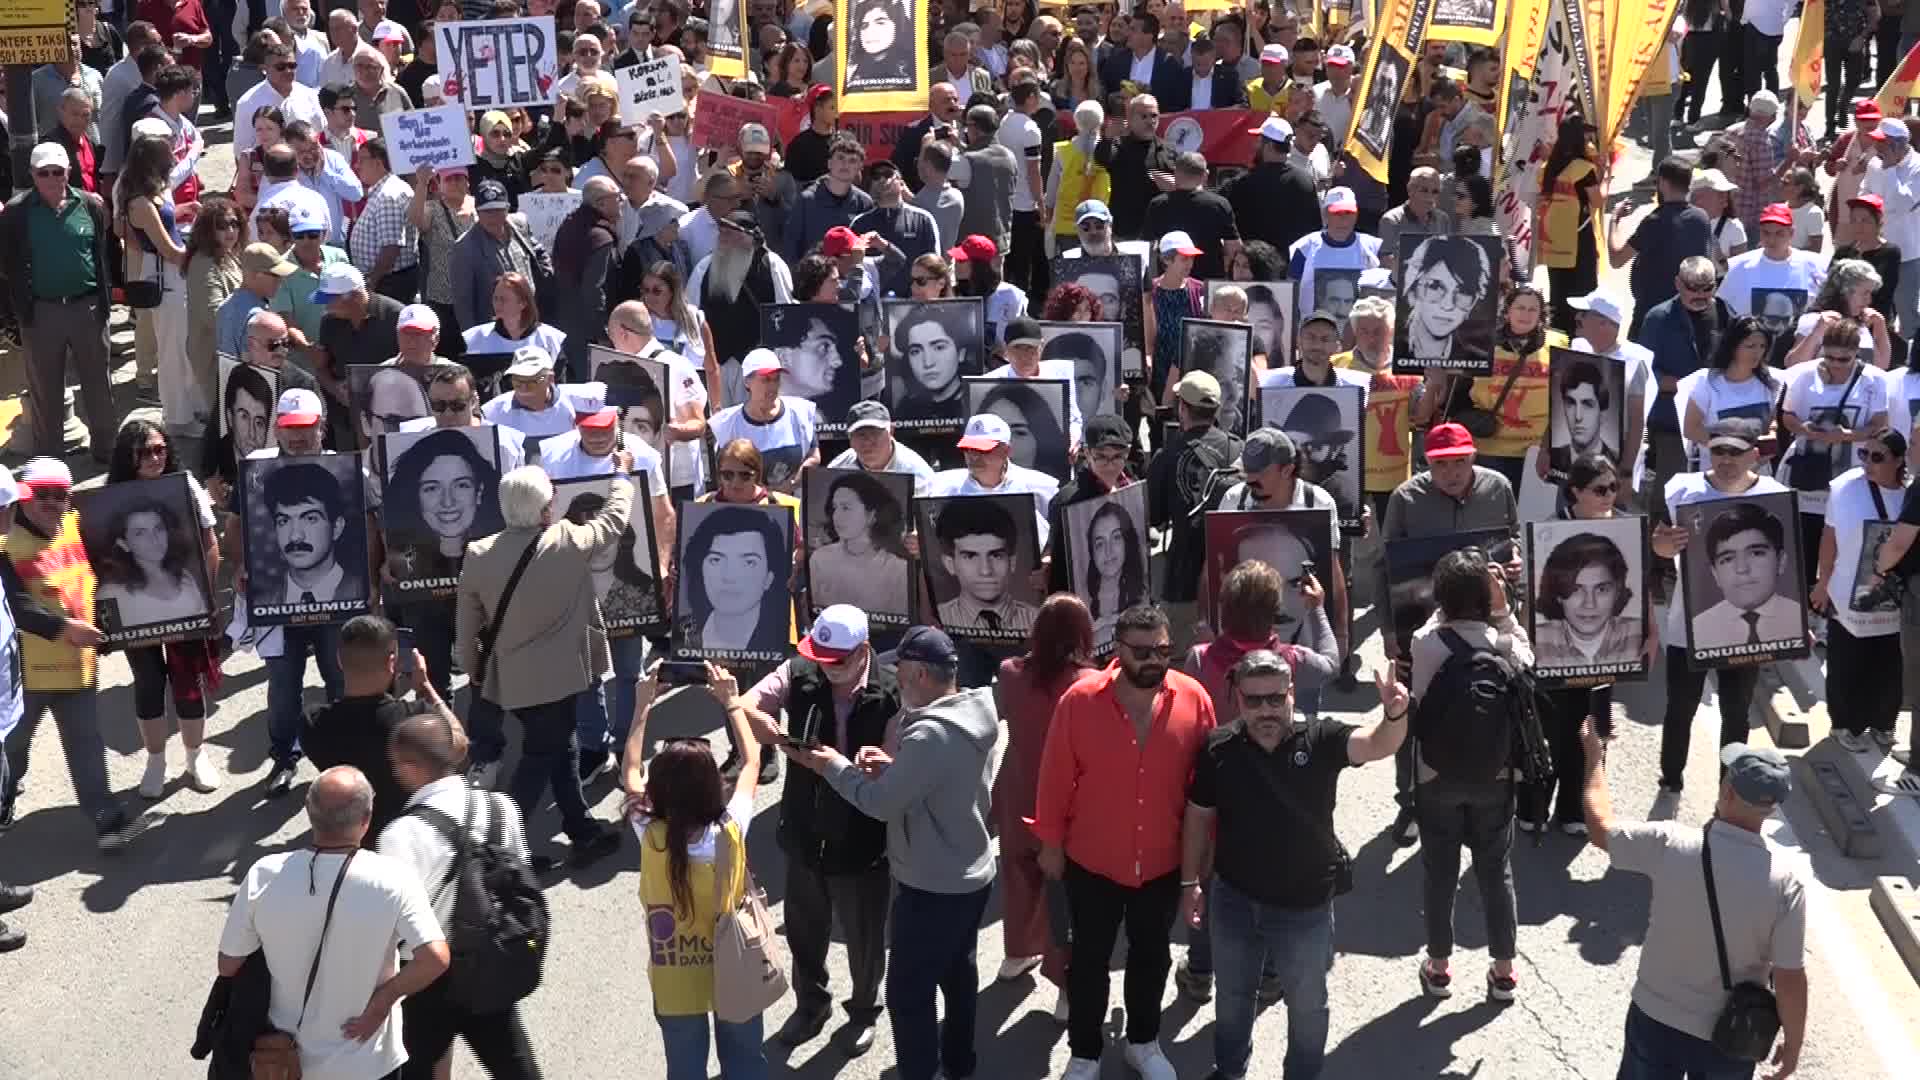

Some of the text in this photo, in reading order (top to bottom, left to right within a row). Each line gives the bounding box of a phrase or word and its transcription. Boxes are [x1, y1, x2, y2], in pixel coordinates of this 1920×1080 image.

[443, 23, 550, 106] YETER
[1397, 358, 1489, 369] ONURUMUZ
[253, 600, 366, 617] ONURUMUZ
[677, 648, 783, 662] ONURUMUZ
[1694, 639, 1804, 660] ONURUMUZ
[1535, 663, 1643, 678] ONURUMUZ
